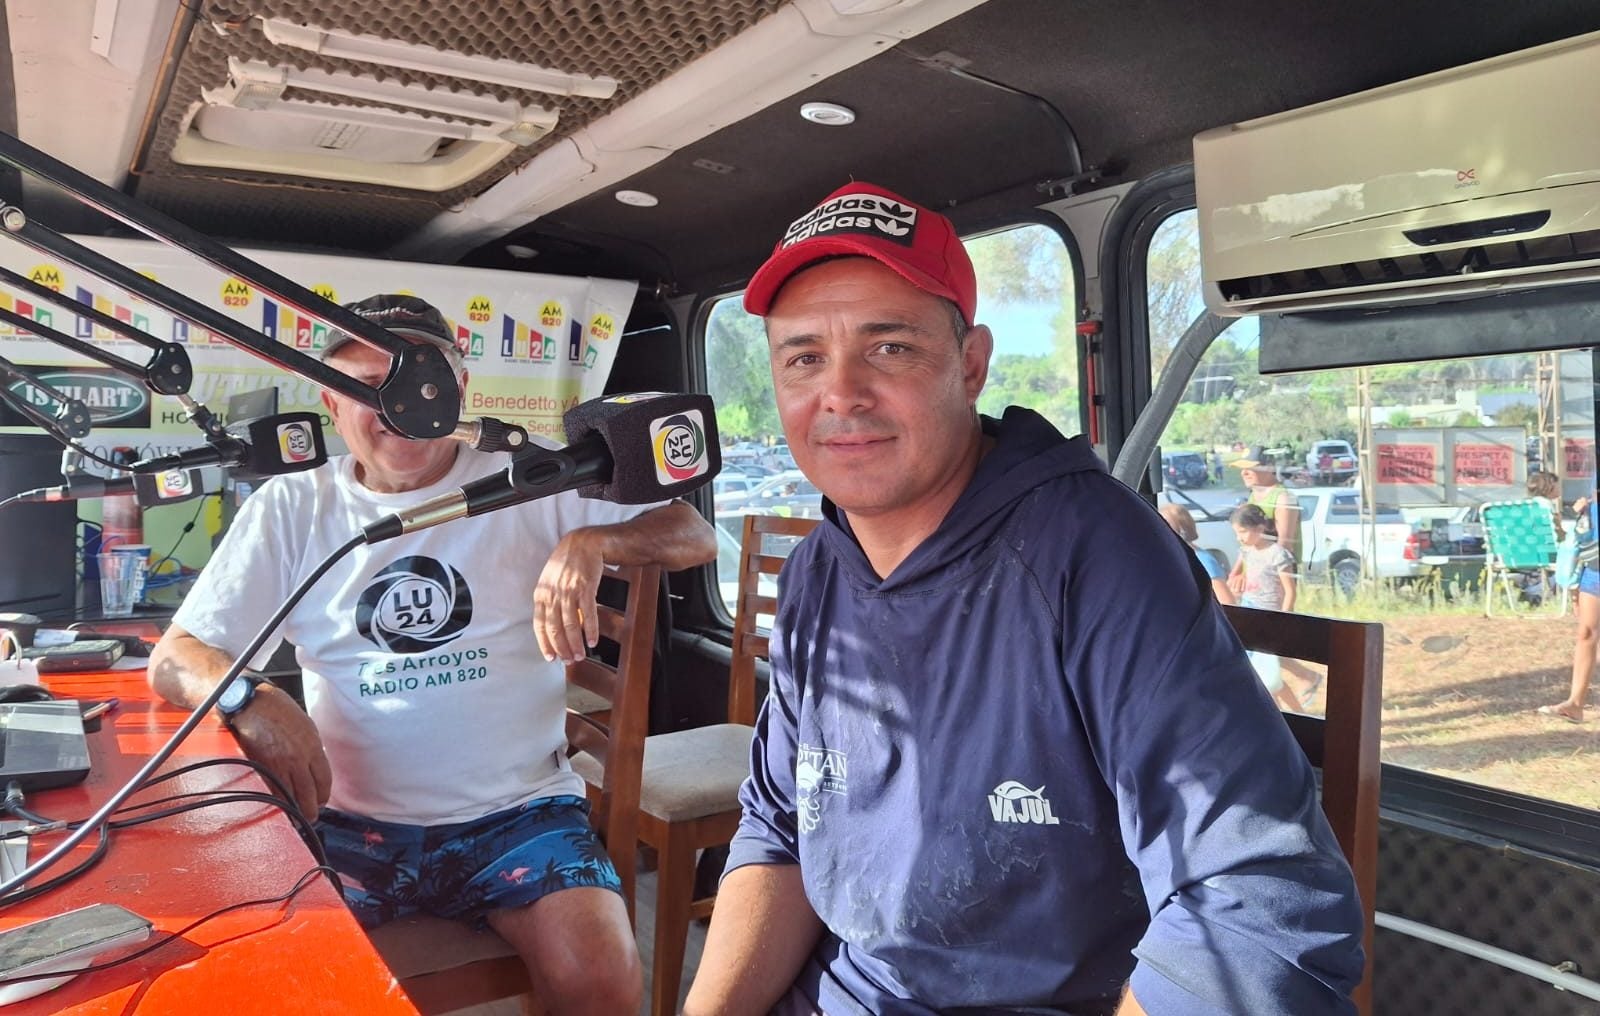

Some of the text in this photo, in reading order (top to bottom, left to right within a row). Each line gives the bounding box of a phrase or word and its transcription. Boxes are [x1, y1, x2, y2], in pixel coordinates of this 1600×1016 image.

[786, 199, 876, 235] adidas
[783, 215, 872, 250] adidas
[32, 270, 60, 283] AM
[224, 283, 249, 295] AM
[223, 297, 249, 307] 820
[470, 301, 490, 312] AM
[469, 312, 490, 323] 820
[542, 306, 562, 316] AM
[541, 318, 562, 328] 820
[593, 318, 612, 332] AM
[590, 326, 609, 341] 820
[472, 393, 556, 411] Benedetto
[528, 420, 564, 435] Segur
[668, 436, 682, 460] 24
[680, 433, 692, 458] LU
[394, 587, 433, 613] LU
[397, 609, 435, 629] 24
[358, 647, 489, 677] Tes Arroyos
[360, 666, 488, 697] RADIO AM 820
[988, 794, 1060, 825] VAJUL
